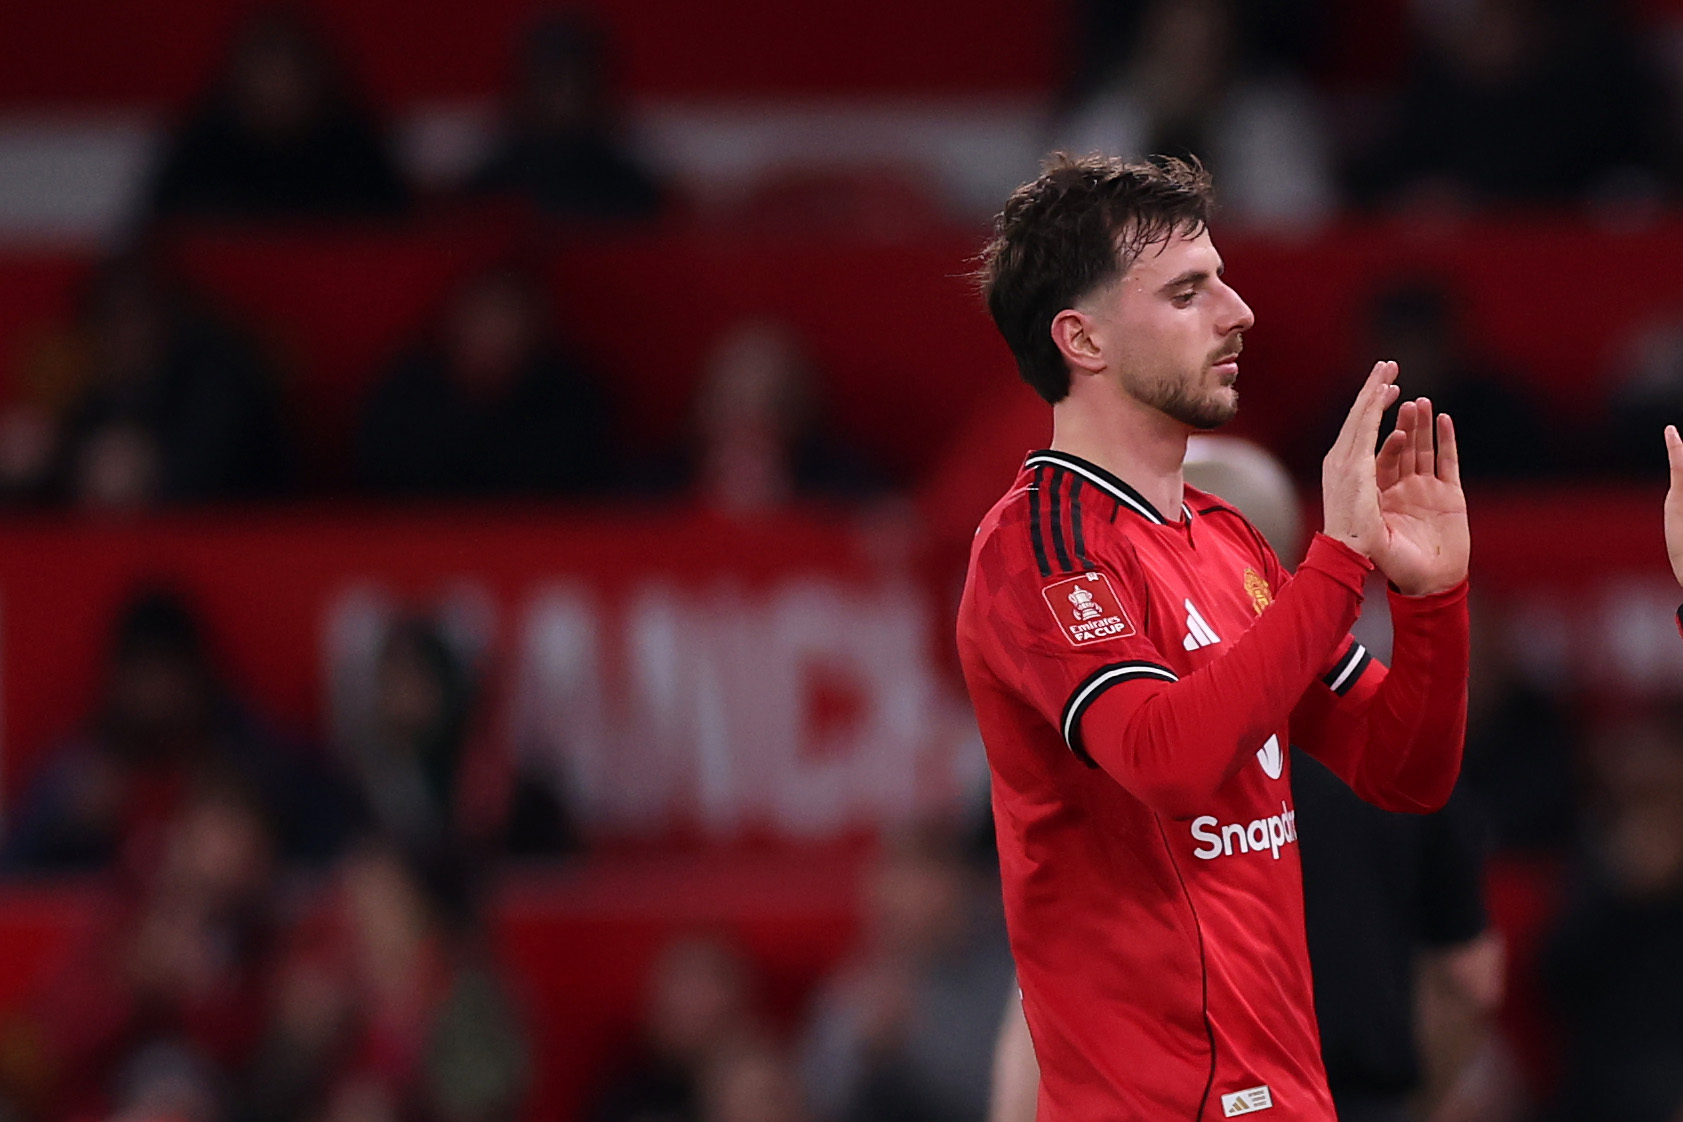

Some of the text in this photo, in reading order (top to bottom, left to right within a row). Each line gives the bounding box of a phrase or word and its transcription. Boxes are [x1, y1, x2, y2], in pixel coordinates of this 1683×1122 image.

[1069, 616, 1121, 634] Emirates
[1074, 623, 1125, 641] FA CUP
